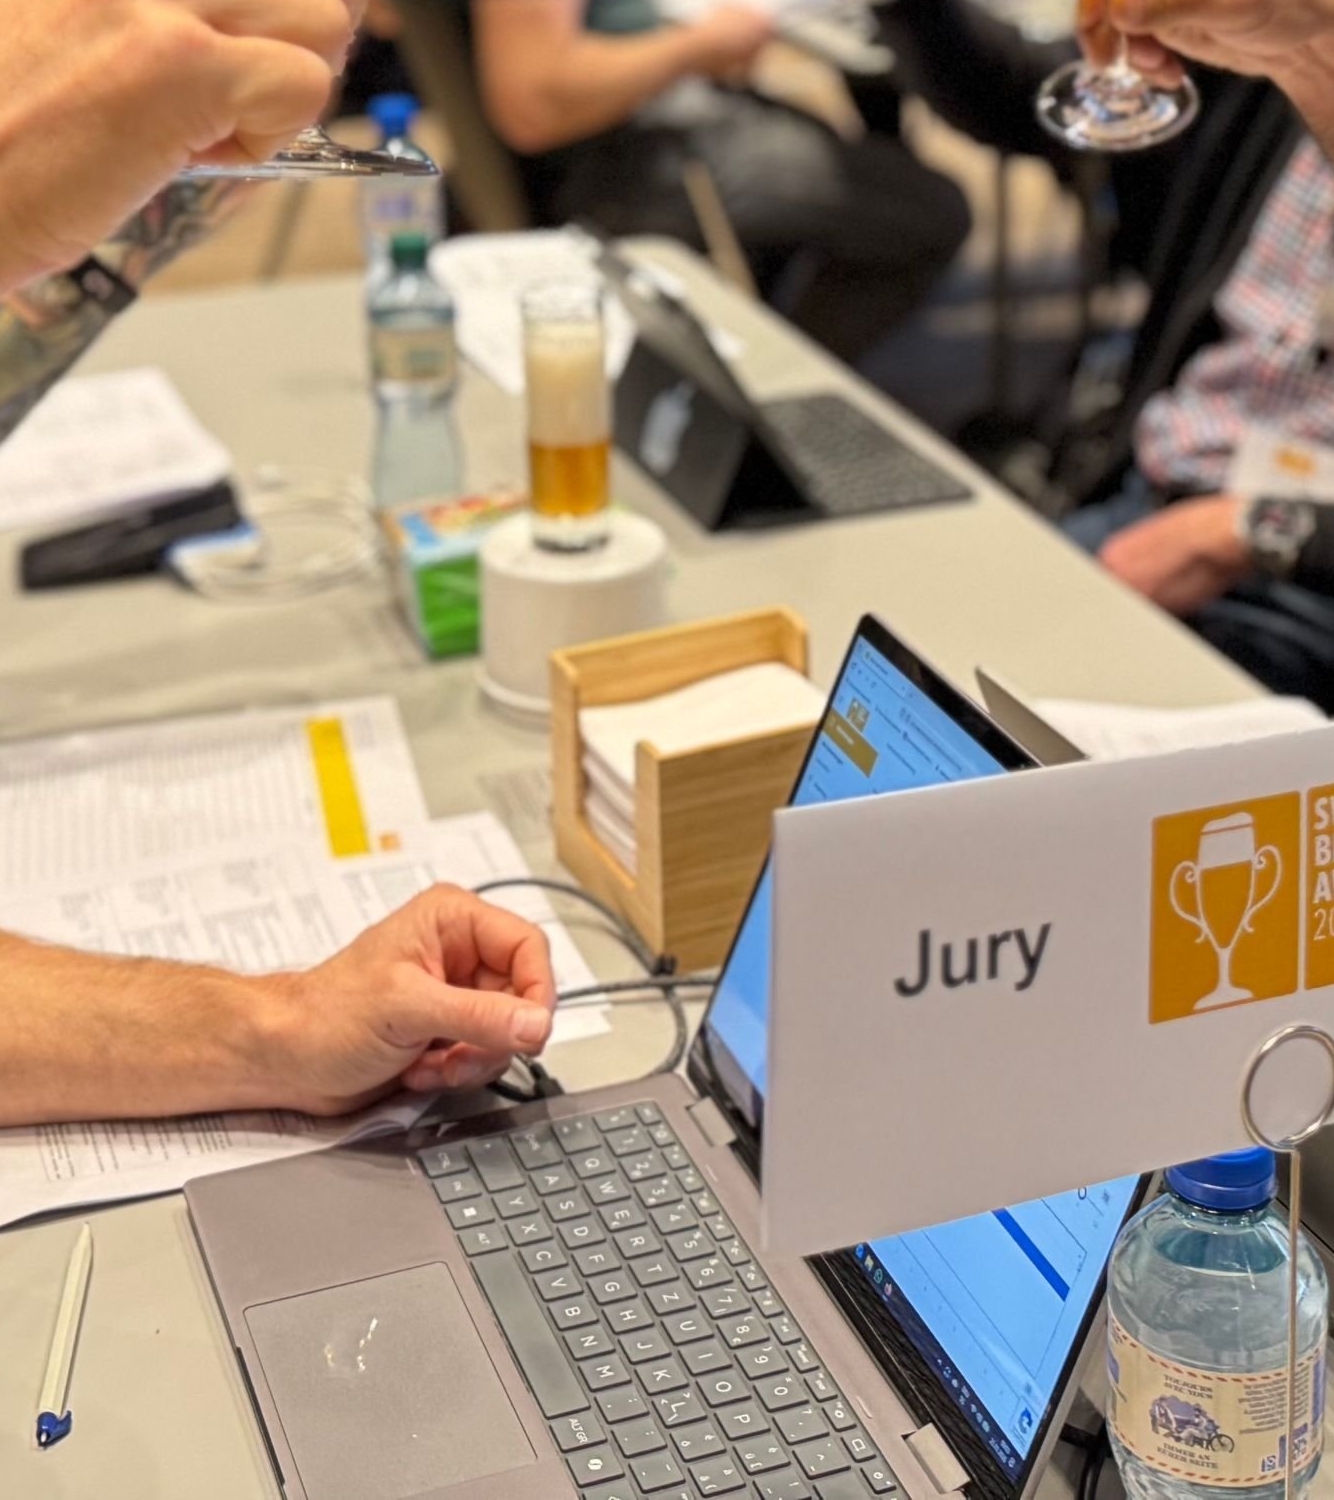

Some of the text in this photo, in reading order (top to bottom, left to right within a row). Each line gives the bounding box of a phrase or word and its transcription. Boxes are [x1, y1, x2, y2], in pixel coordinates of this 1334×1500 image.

[893, 921, 1052, 998] Jury
[585, 1158, 600, 1169] Q
[636, 1162, 649, 1172] 2
[545, 1175, 560, 1184] A
[599, 1181, 616, 1195] W
[652, 1187, 665, 1196] 3
[509, 1197, 524, 1207] Y
[560, 1201, 574, 1210] S
[614, 1210, 630, 1220] E
[520, 1223, 537, 1234] X
[573, 1226, 588, 1236] D
[629, 1236, 645, 1247] R
[684, 1240, 698, 1249] 5
[536, 1251, 551, 1261] C
[588, 1254, 605, 1264] F
[647, 1264, 662, 1274] T
[701, 1267, 714, 1276] 6
[550, 1277, 567, 1288] V
[605, 1281, 620, 1292] G
[662, 1292, 679, 1303] Z
[565, 1306, 581, 1317] B
[619, 1309, 637, 1320] H
[679, 1320, 696, 1331] U
[736, 1325, 750, 1334] 8
[580, 1335, 598, 1347] N
[637, 1341, 653, 1350] J
[754, 1355, 769, 1364] 9
[596, 1365, 615, 1378] M
[653, 1370, 671, 1381] K
[734, 1414, 750, 1424] P
